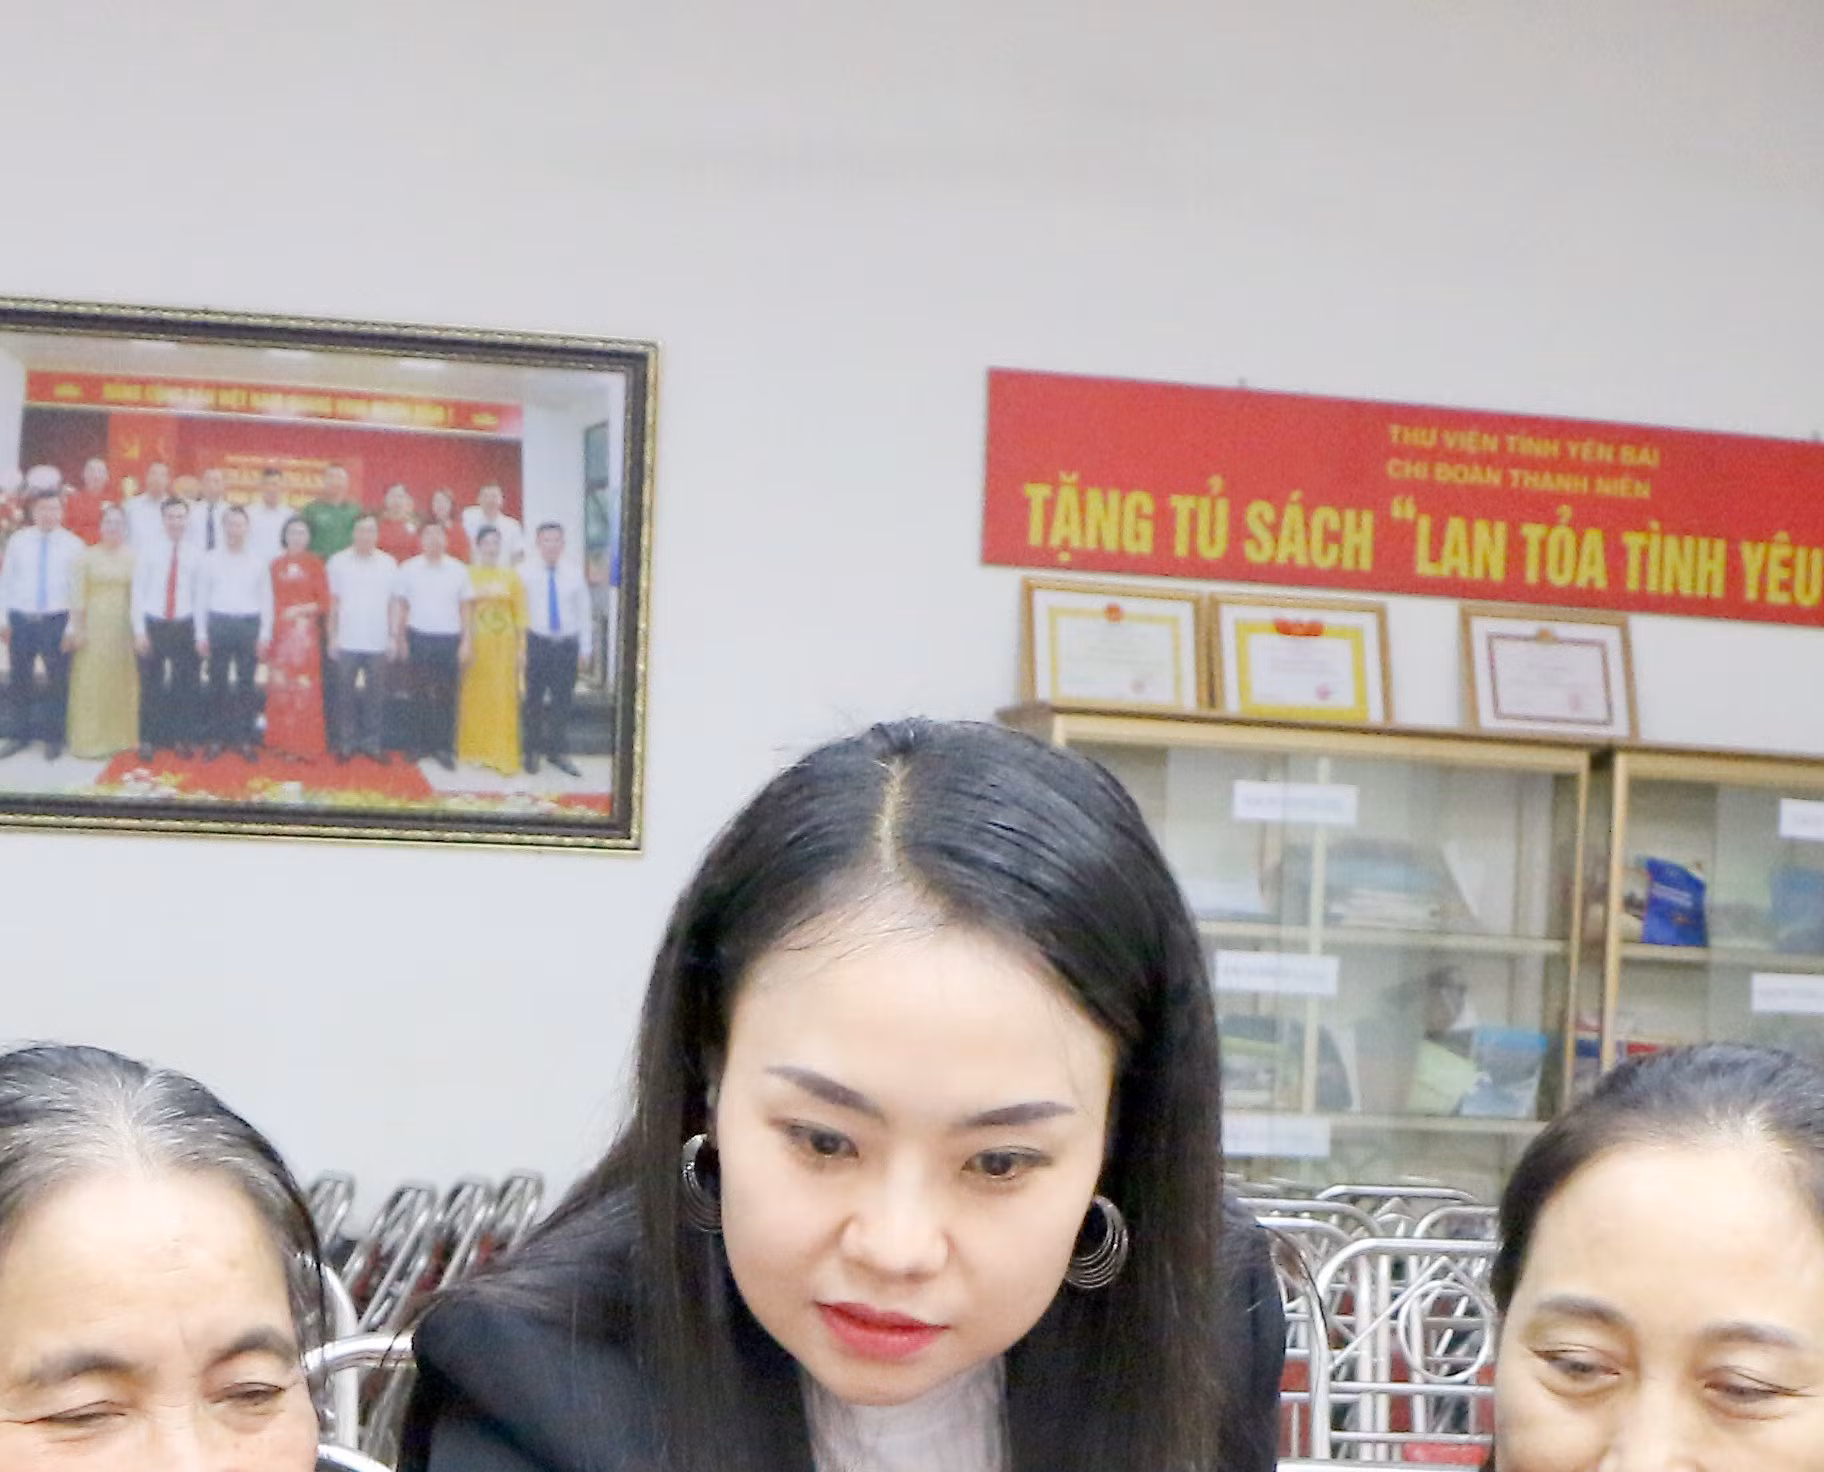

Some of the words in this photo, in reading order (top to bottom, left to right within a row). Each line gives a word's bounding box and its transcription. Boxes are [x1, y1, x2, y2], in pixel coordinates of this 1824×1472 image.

[1386, 457, 1428, 481] CHI
[1509, 468, 1588, 494] THANH
[1024, 470, 1155, 562] TẶNG
[1170, 474, 1230, 560] TỦ
[1244, 489, 1374, 571] SÁCH
[1520, 503, 1608, 590] TỎA
[1622, 519, 1726, 599] TÌNH
[1739, 530, 1824, 607] YÊU
